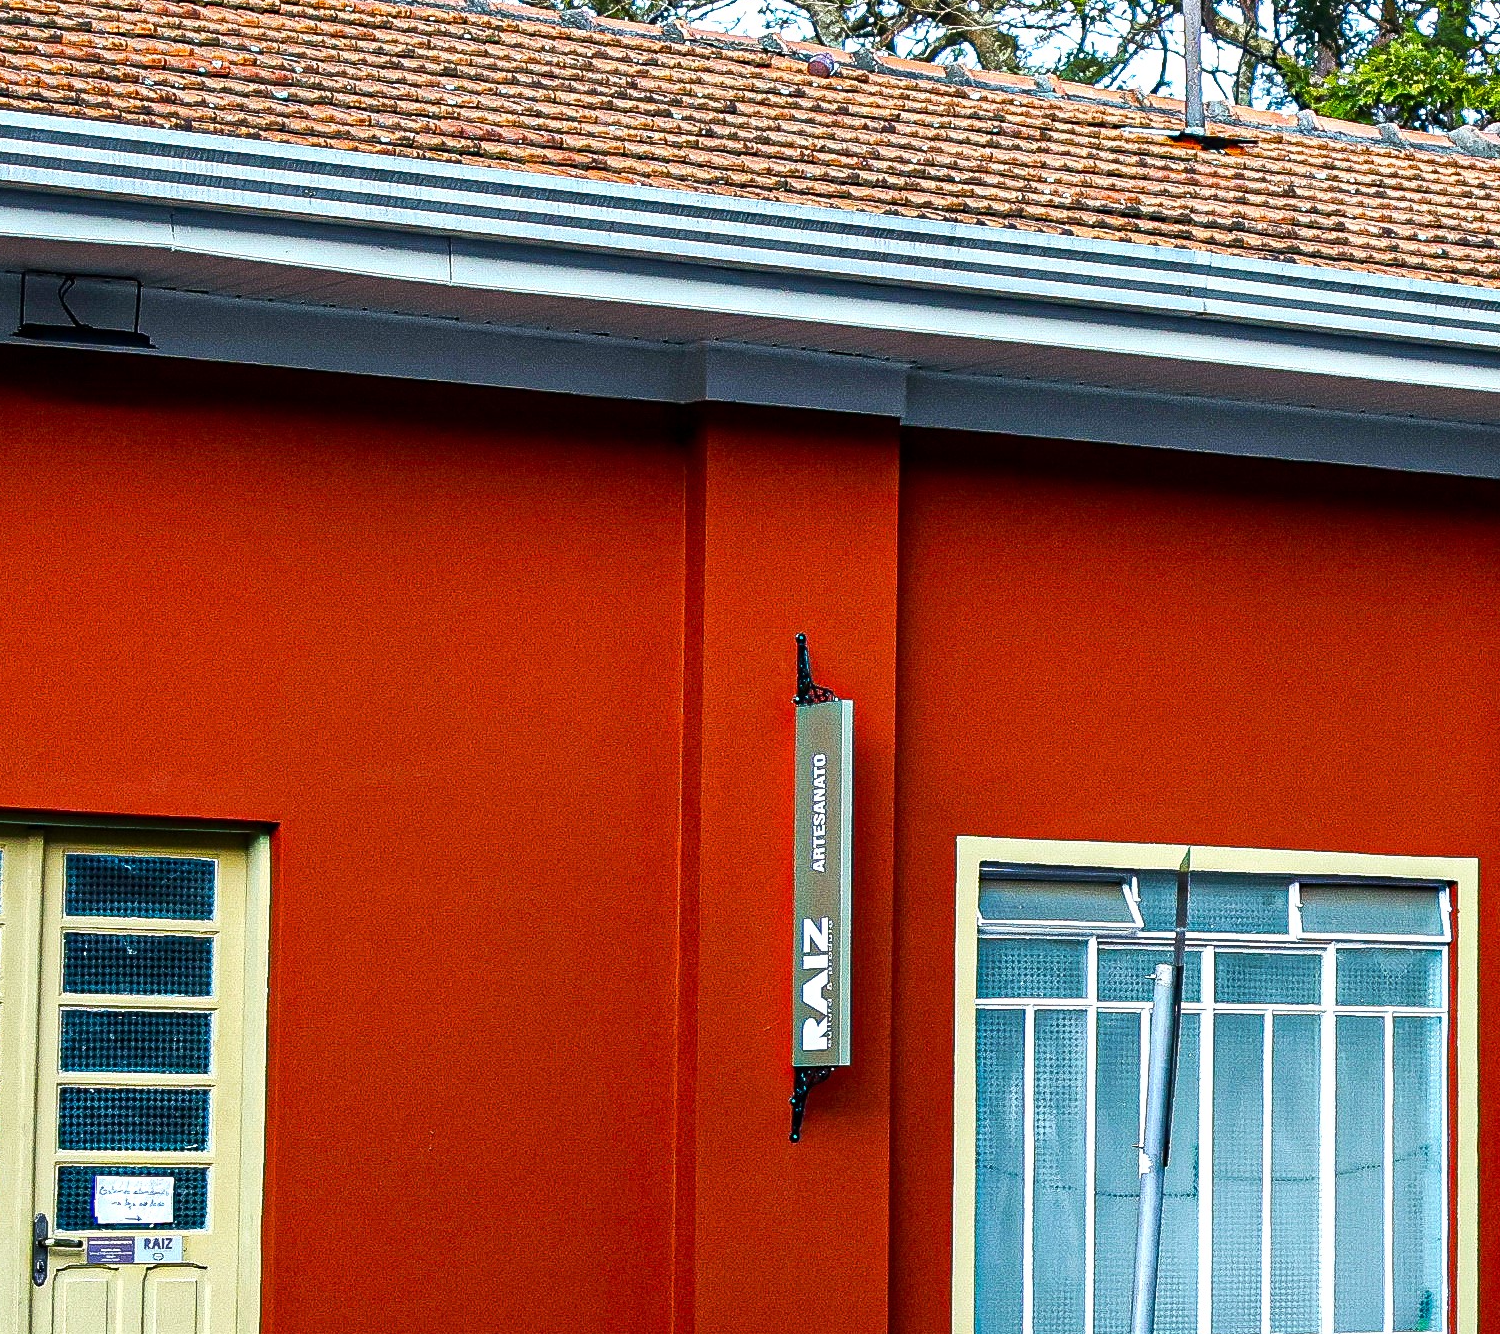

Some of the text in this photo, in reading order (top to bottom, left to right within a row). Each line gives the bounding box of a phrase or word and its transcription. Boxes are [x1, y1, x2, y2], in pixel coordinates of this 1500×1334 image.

[811, 753, 828, 873] ARTESANATO
[801, 916, 829, 1052] RAIZ
[143, 1238, 173, 1250] RAIZ
